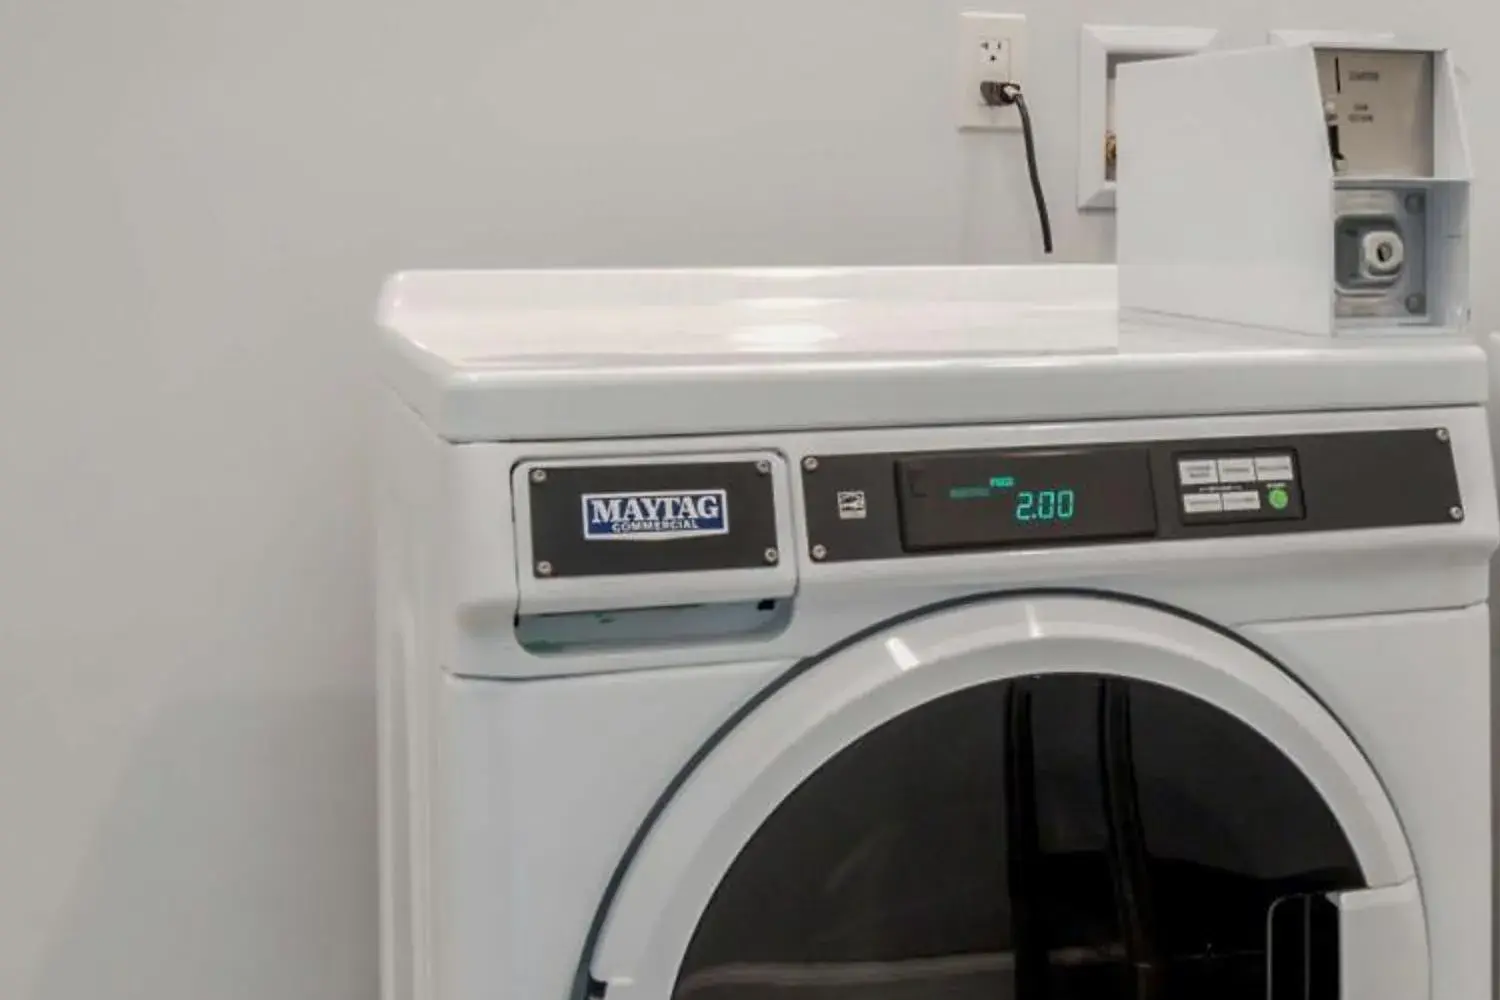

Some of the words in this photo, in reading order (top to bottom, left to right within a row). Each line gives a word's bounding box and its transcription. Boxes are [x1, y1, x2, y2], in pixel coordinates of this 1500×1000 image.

[591, 496, 719, 523] MAYTAG
[1016, 490, 1075, 520] 2.00
[611, 519, 699, 533] COMMERCIAL
